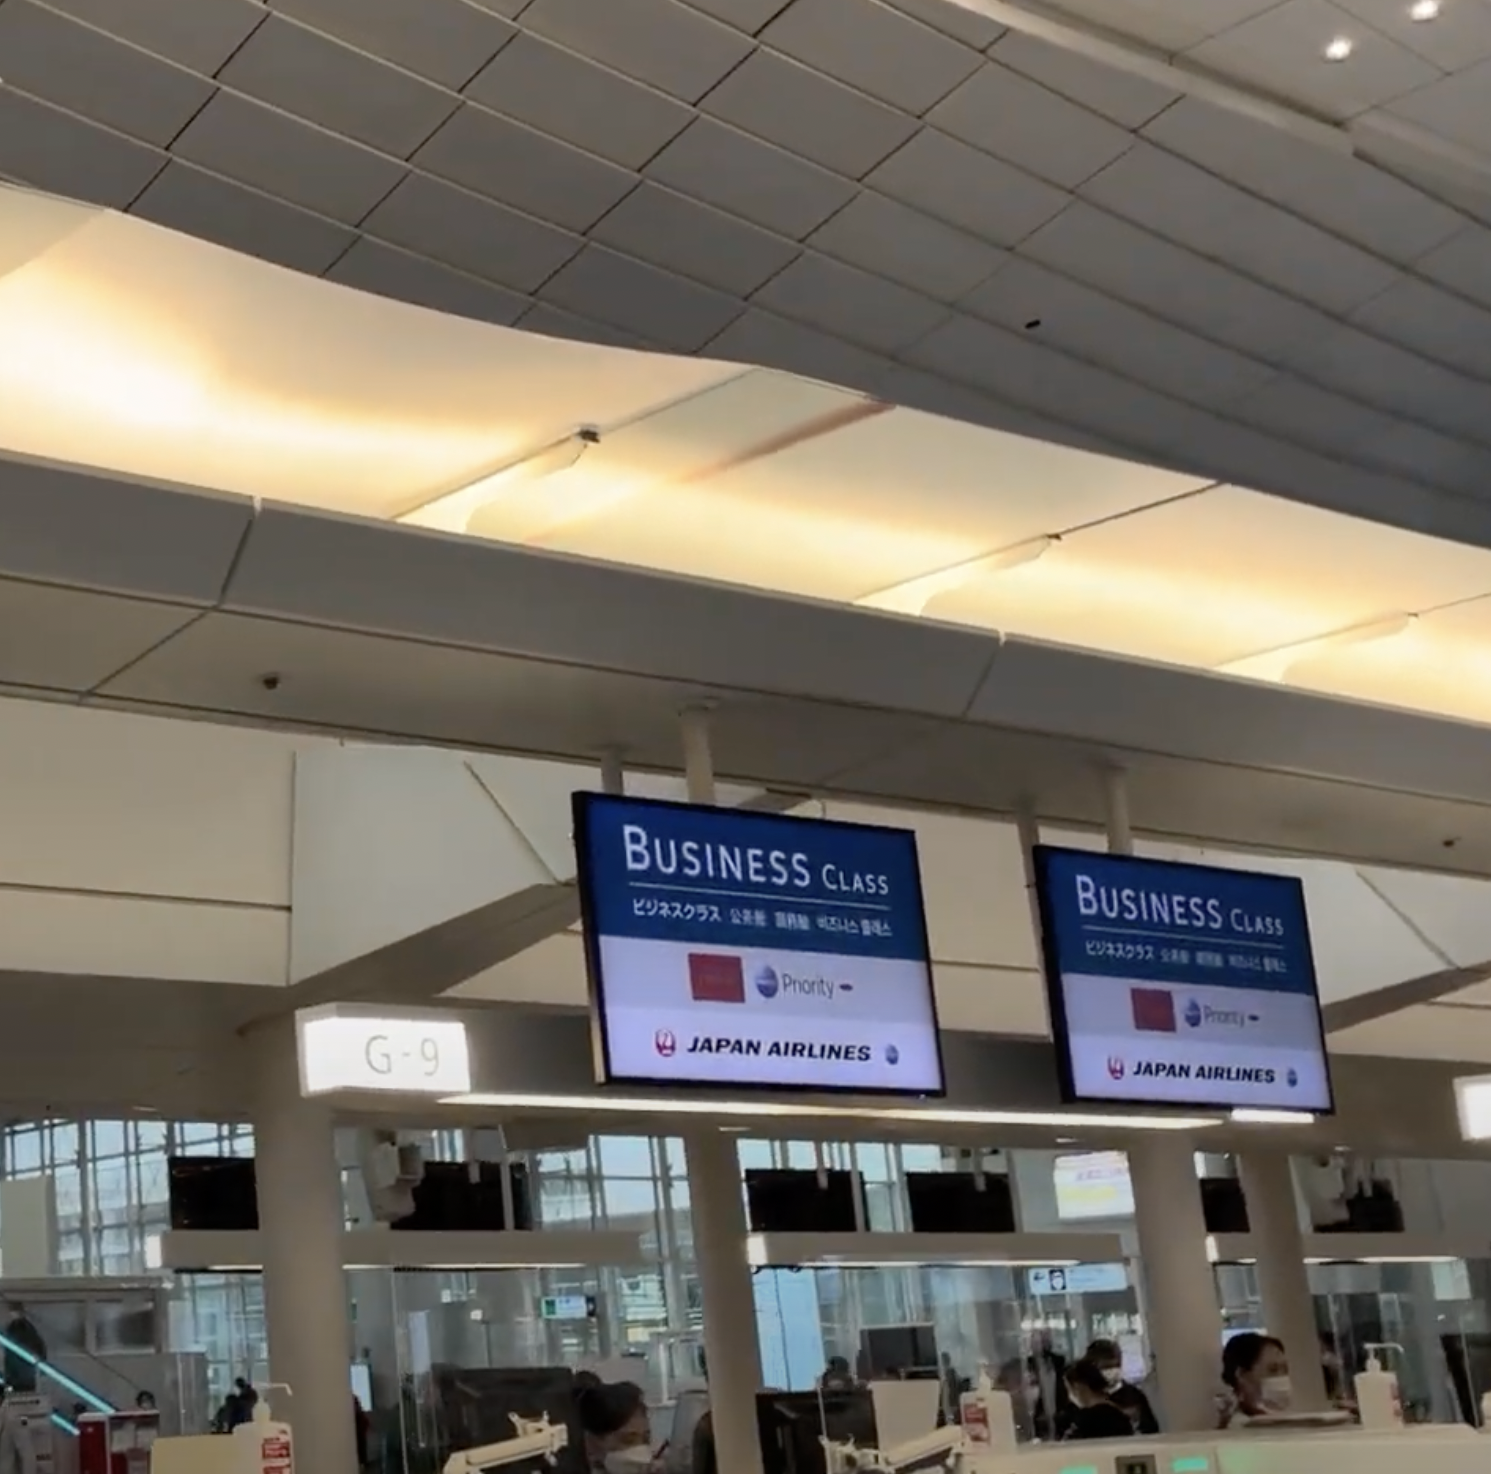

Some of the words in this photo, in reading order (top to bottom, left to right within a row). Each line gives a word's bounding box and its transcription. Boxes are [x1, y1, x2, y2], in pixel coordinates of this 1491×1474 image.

[622, 824, 811, 888] BUSINESS
[821, 863, 890, 895] CLASS
[1075, 874, 1223, 930] BUSINESS
[1230, 908, 1285, 936] CLASS
[687, 1036, 762, 1056] JAPAN
[767, 1041, 872, 1063] AIRLINES
[1132, 1060, 1192, 1079] JAPAN
[1194, 1065, 1277, 1085] AIRLINES
